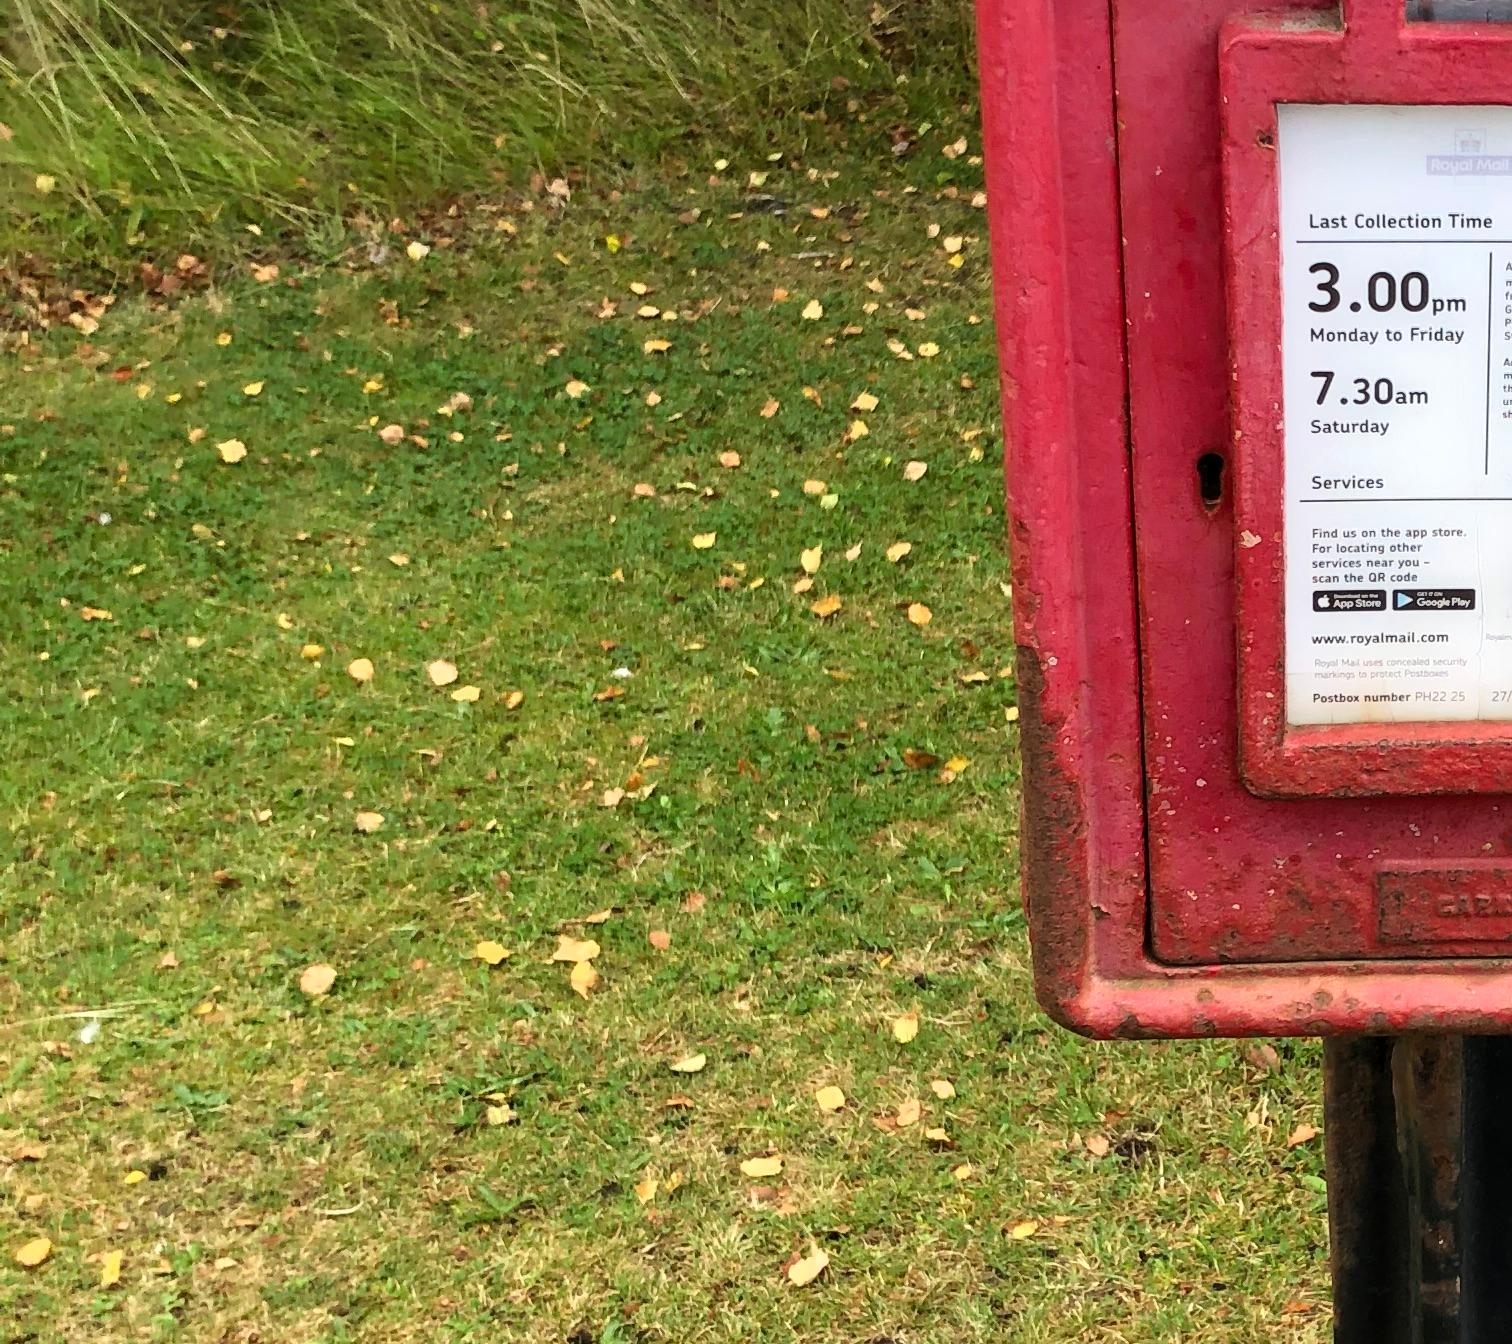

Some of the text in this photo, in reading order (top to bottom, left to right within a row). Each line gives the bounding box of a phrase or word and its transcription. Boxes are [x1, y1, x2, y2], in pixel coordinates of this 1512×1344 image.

[1431, 158, 1510, 174] Royal Mail
[1309, 213, 1493, 229] Last Collection Time
[1505, 262, 1512, 272] A
[1308, 261, 1466, 316] 3.00pm
[1310, 327, 1465, 345] Monday to Friday
[1310, 371, 1429, 406] 7.30am
[1310, 419, 1390, 436] Saturday
[1312, 476, 1384, 490] Services
[1312, 528, 1467, 540] Find us on the app store.
[1312, 542, 1423, 555] For locating other
[1312, 558, 1362, 568] services
[1366, 559, 1394, 568] near
[1398, 559, 1420, 570] you
[1312, 572, 1418, 584] scan the QR code
[1333, 598, 1382, 609] App Store
[1416, 597, 1471, 609] Google Play
[1312, 633, 1449, 646] www.royalmail.com
[1314, 657, 1467, 668] Royal Mail uses concealed security
[1314, 670, 1355, 680] markings
[1358, 670, 1367, 678] to
[1370, 670, 1401, 680] protect
[1313, 691, 1465, 703] Postbox number PH22 25
